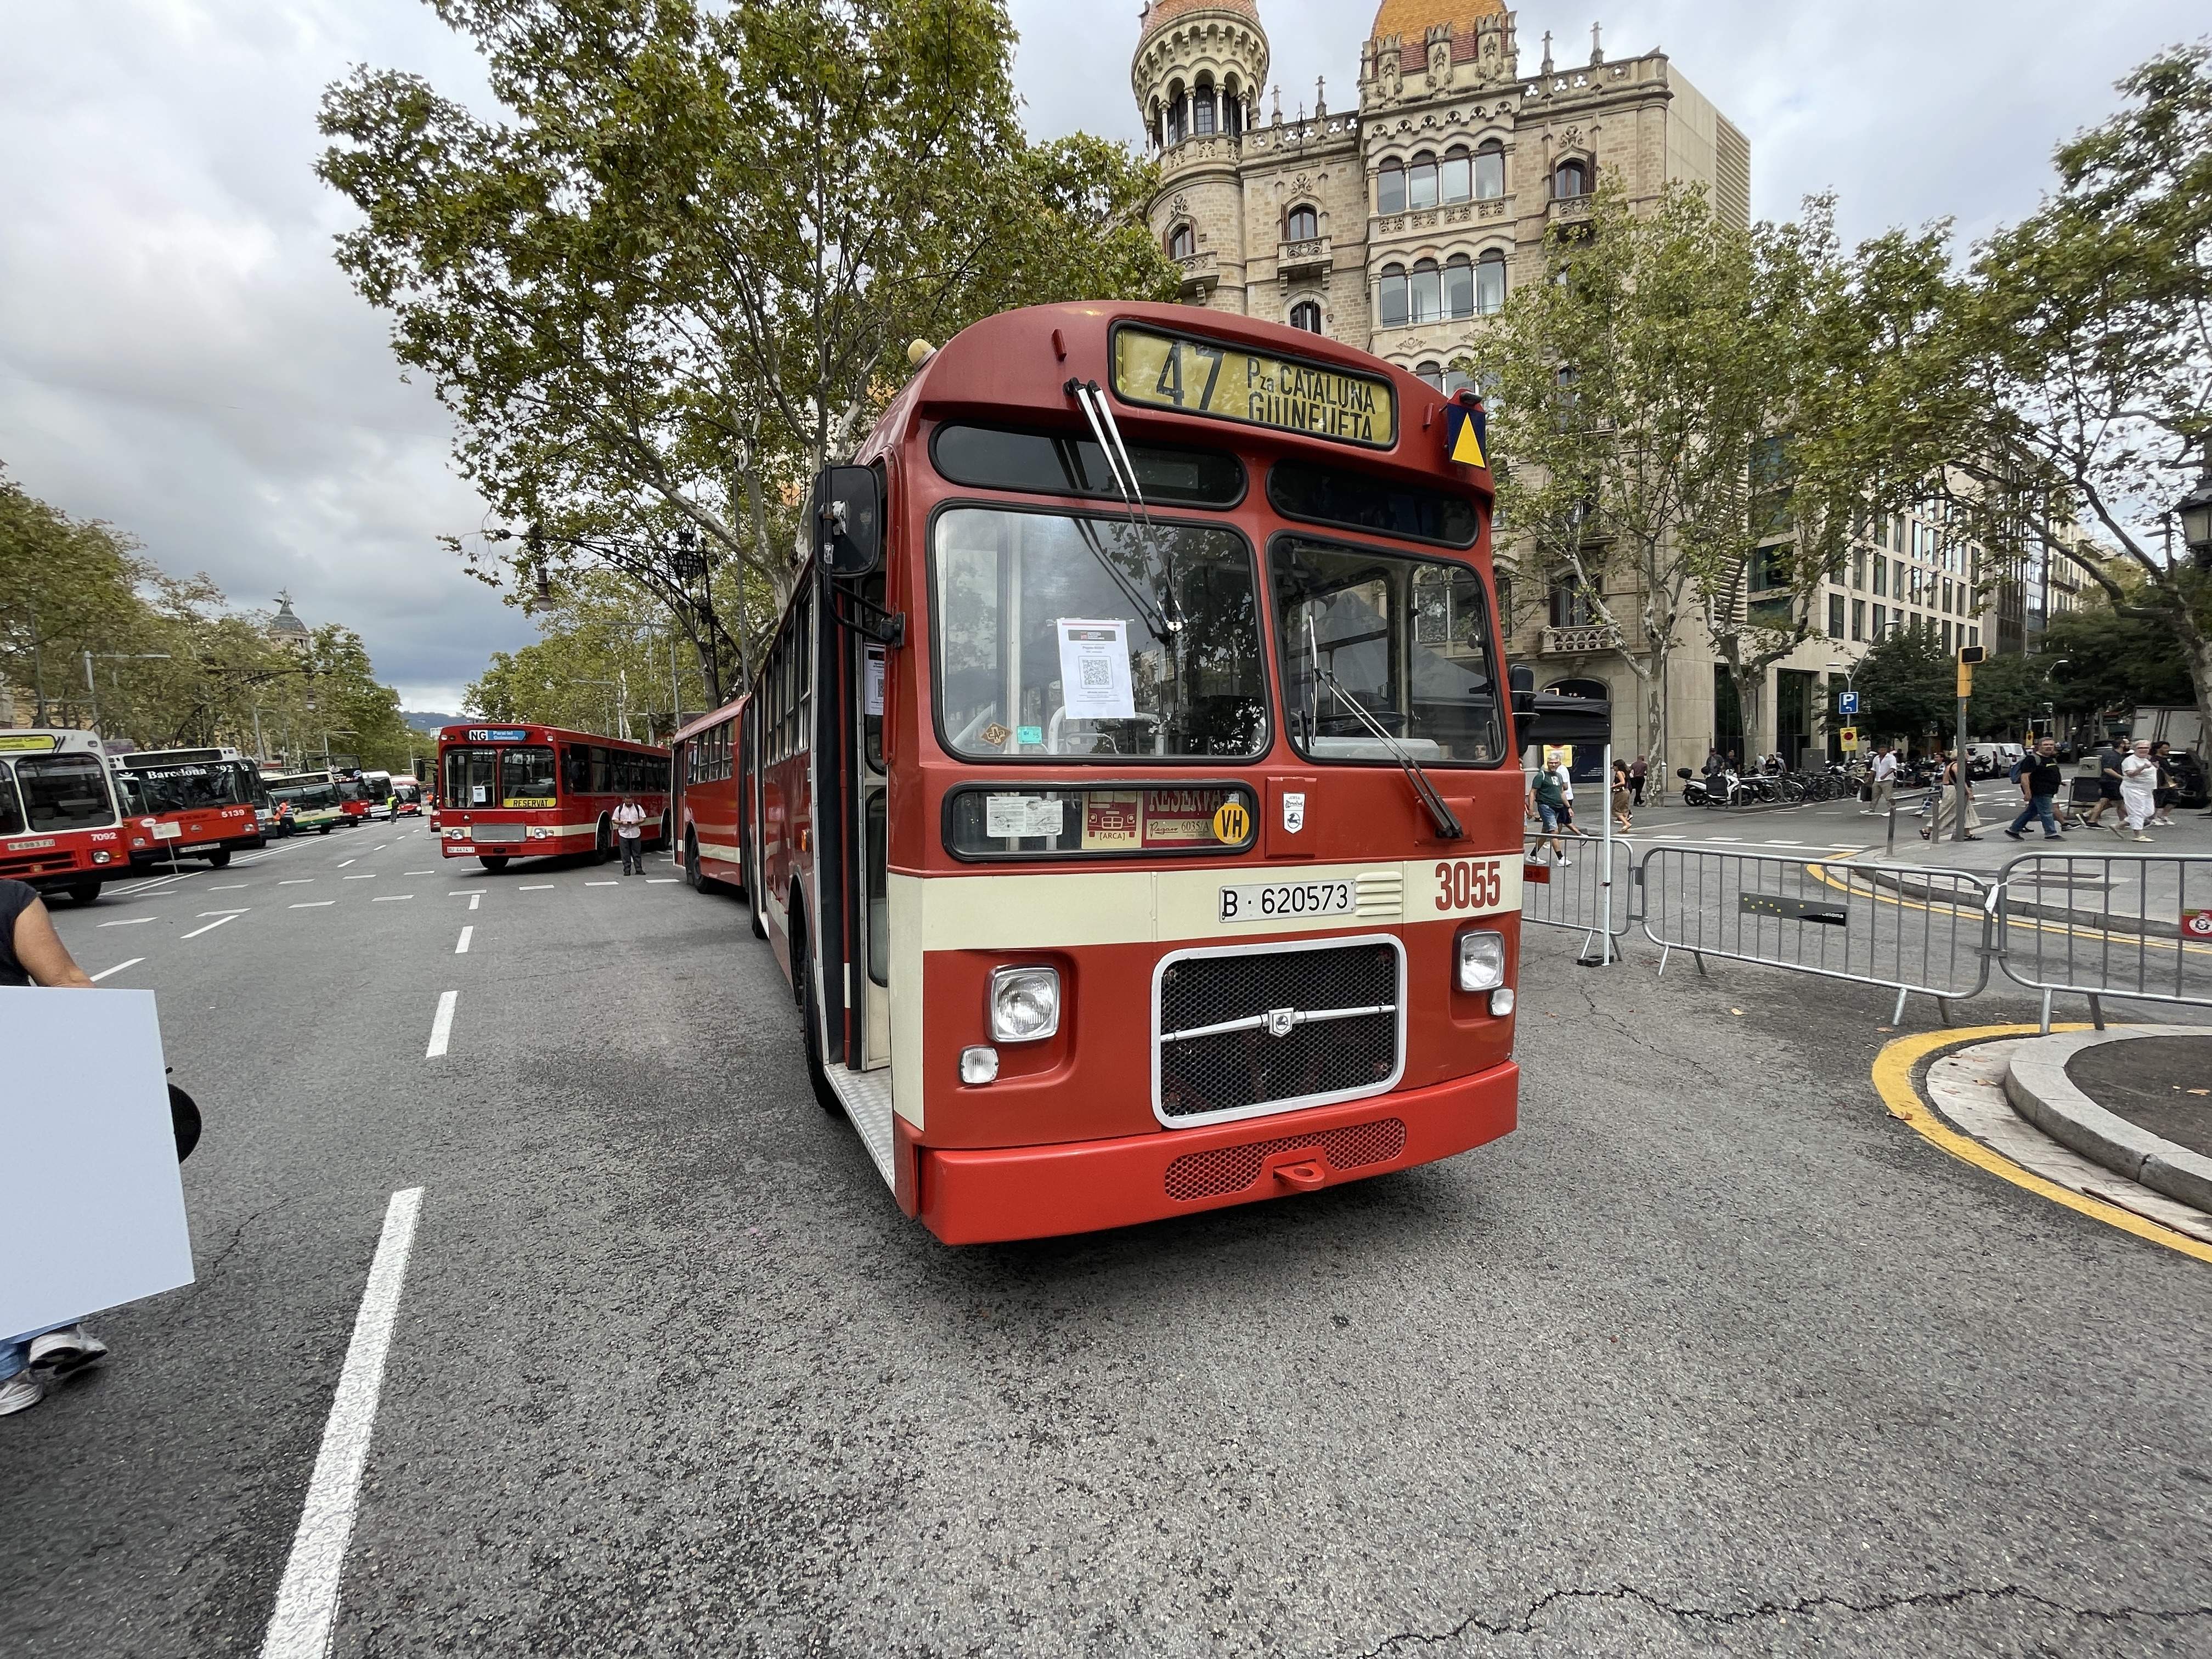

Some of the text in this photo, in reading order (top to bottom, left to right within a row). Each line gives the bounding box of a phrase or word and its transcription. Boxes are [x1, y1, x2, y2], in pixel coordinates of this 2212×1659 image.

[1156, 339, 1226, 411] 47
[1246, 357, 1274, 393] Pza
[1843, 693, 1854, 706] P
[471, 731, 486, 740] NG
[146, 768, 207, 780] Barcelona
[221, 809, 245, 818] 5139
[1181, 821, 1209, 831] 6035/A
[1221, 809, 1243, 838] VH
[91, 832, 117, 842] 7092
[1099, 831, 1126, 840] [ARCA]
[1435, 861, 1501, 911] 3055
[1222, 884, 1348, 917] B 620573
